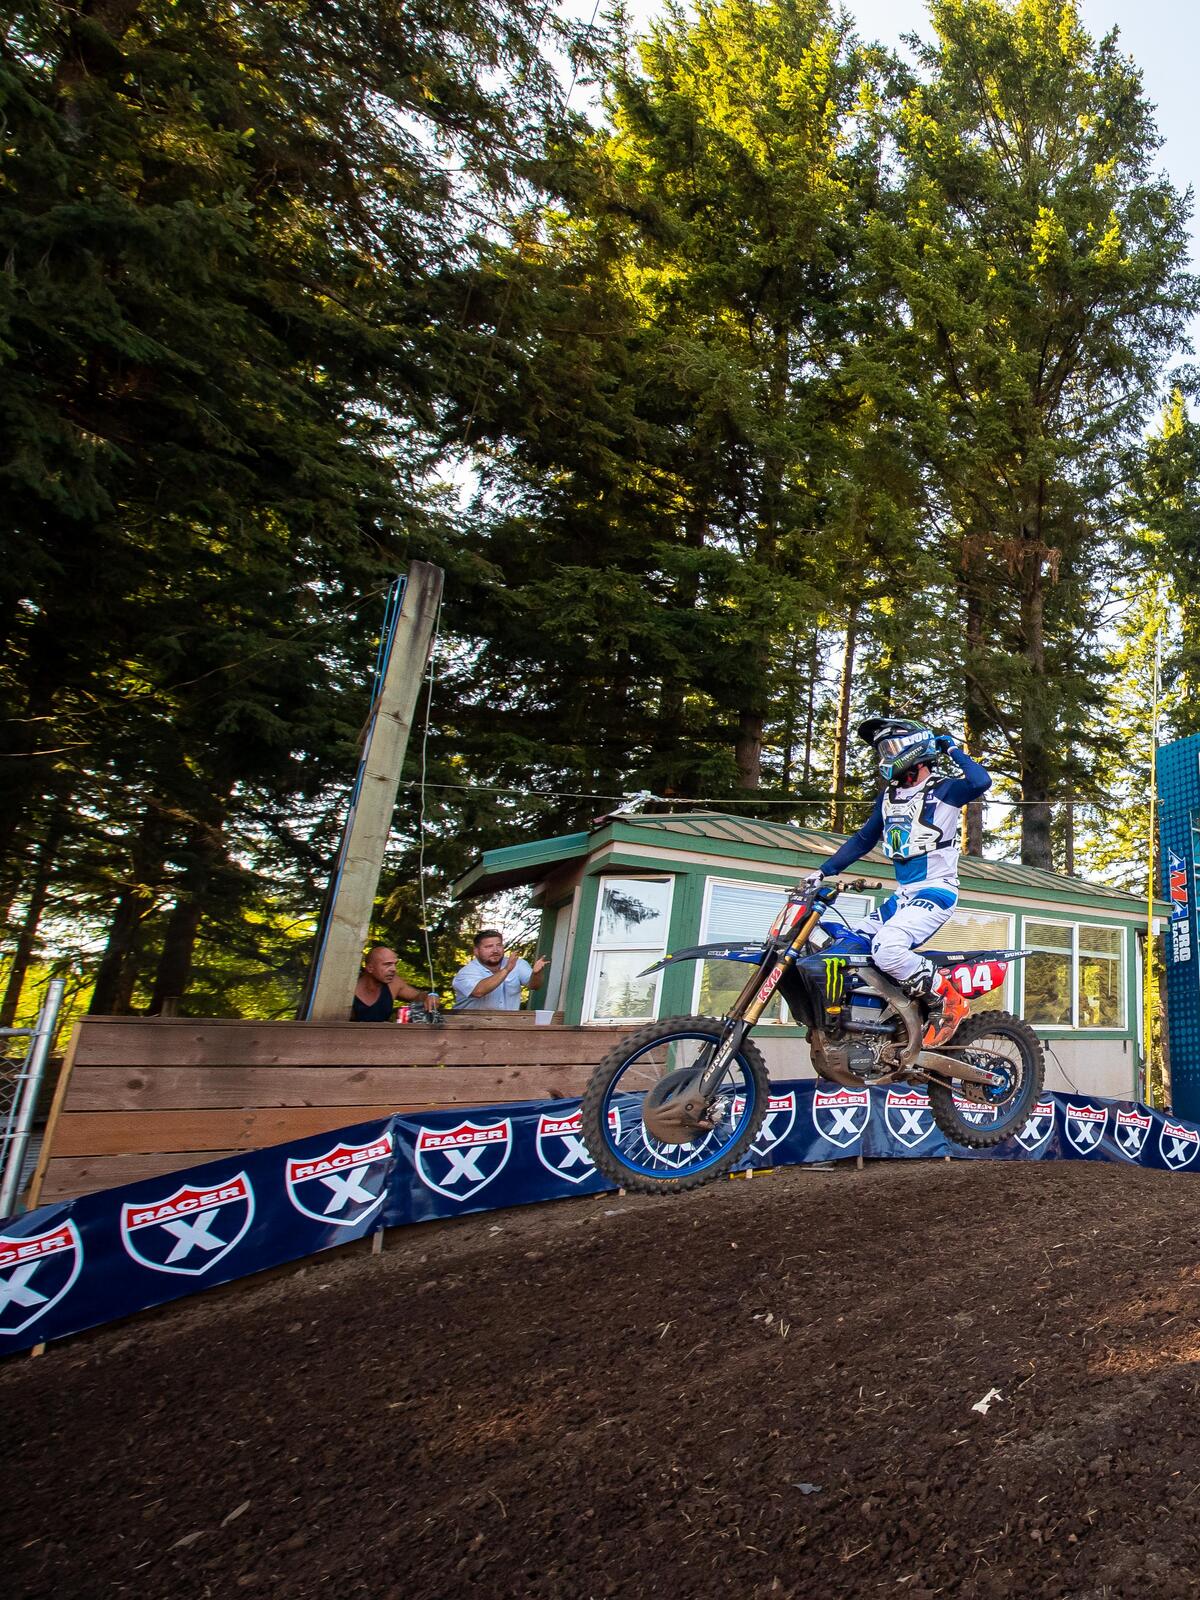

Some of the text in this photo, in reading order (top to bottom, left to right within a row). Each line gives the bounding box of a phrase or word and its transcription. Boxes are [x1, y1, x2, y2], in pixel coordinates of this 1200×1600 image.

[1172, 922, 1181, 963] RACING
[1178, 920, 1192, 962] PRO
[758, 967, 783, 1003] KYB
[954, 965, 994, 994] 14
[818, 1096, 865, 1105] RACER
[1069, 1110, 1104, 1120] RACER
[544, 1120, 583, 1133] RAC
[828, 1107, 860, 1136] X
[897, 1109, 925, 1135] X
[1020, 1116, 1043, 1139] X
[1075, 1120, 1099, 1144] X
[1119, 1115, 1148, 1127] RACER
[1165, 1127, 1197, 1140] RACER
[424, 1129, 504, 1148] RACER
[1123, 1126, 1141, 1148] X
[1167, 1137, 1190, 1162] X
[294, 1143, 387, 1179] RACER
[439, 1145, 487, 1186] X
[556, 1135, 596, 1169] X
[319, 1164, 378, 1216] X
[132, 1185, 241, 1226] RACER
[0, 1235, 67, 1265] CER
[160, 1207, 229, 1265] X
[0, 1259, 50, 1315] X
